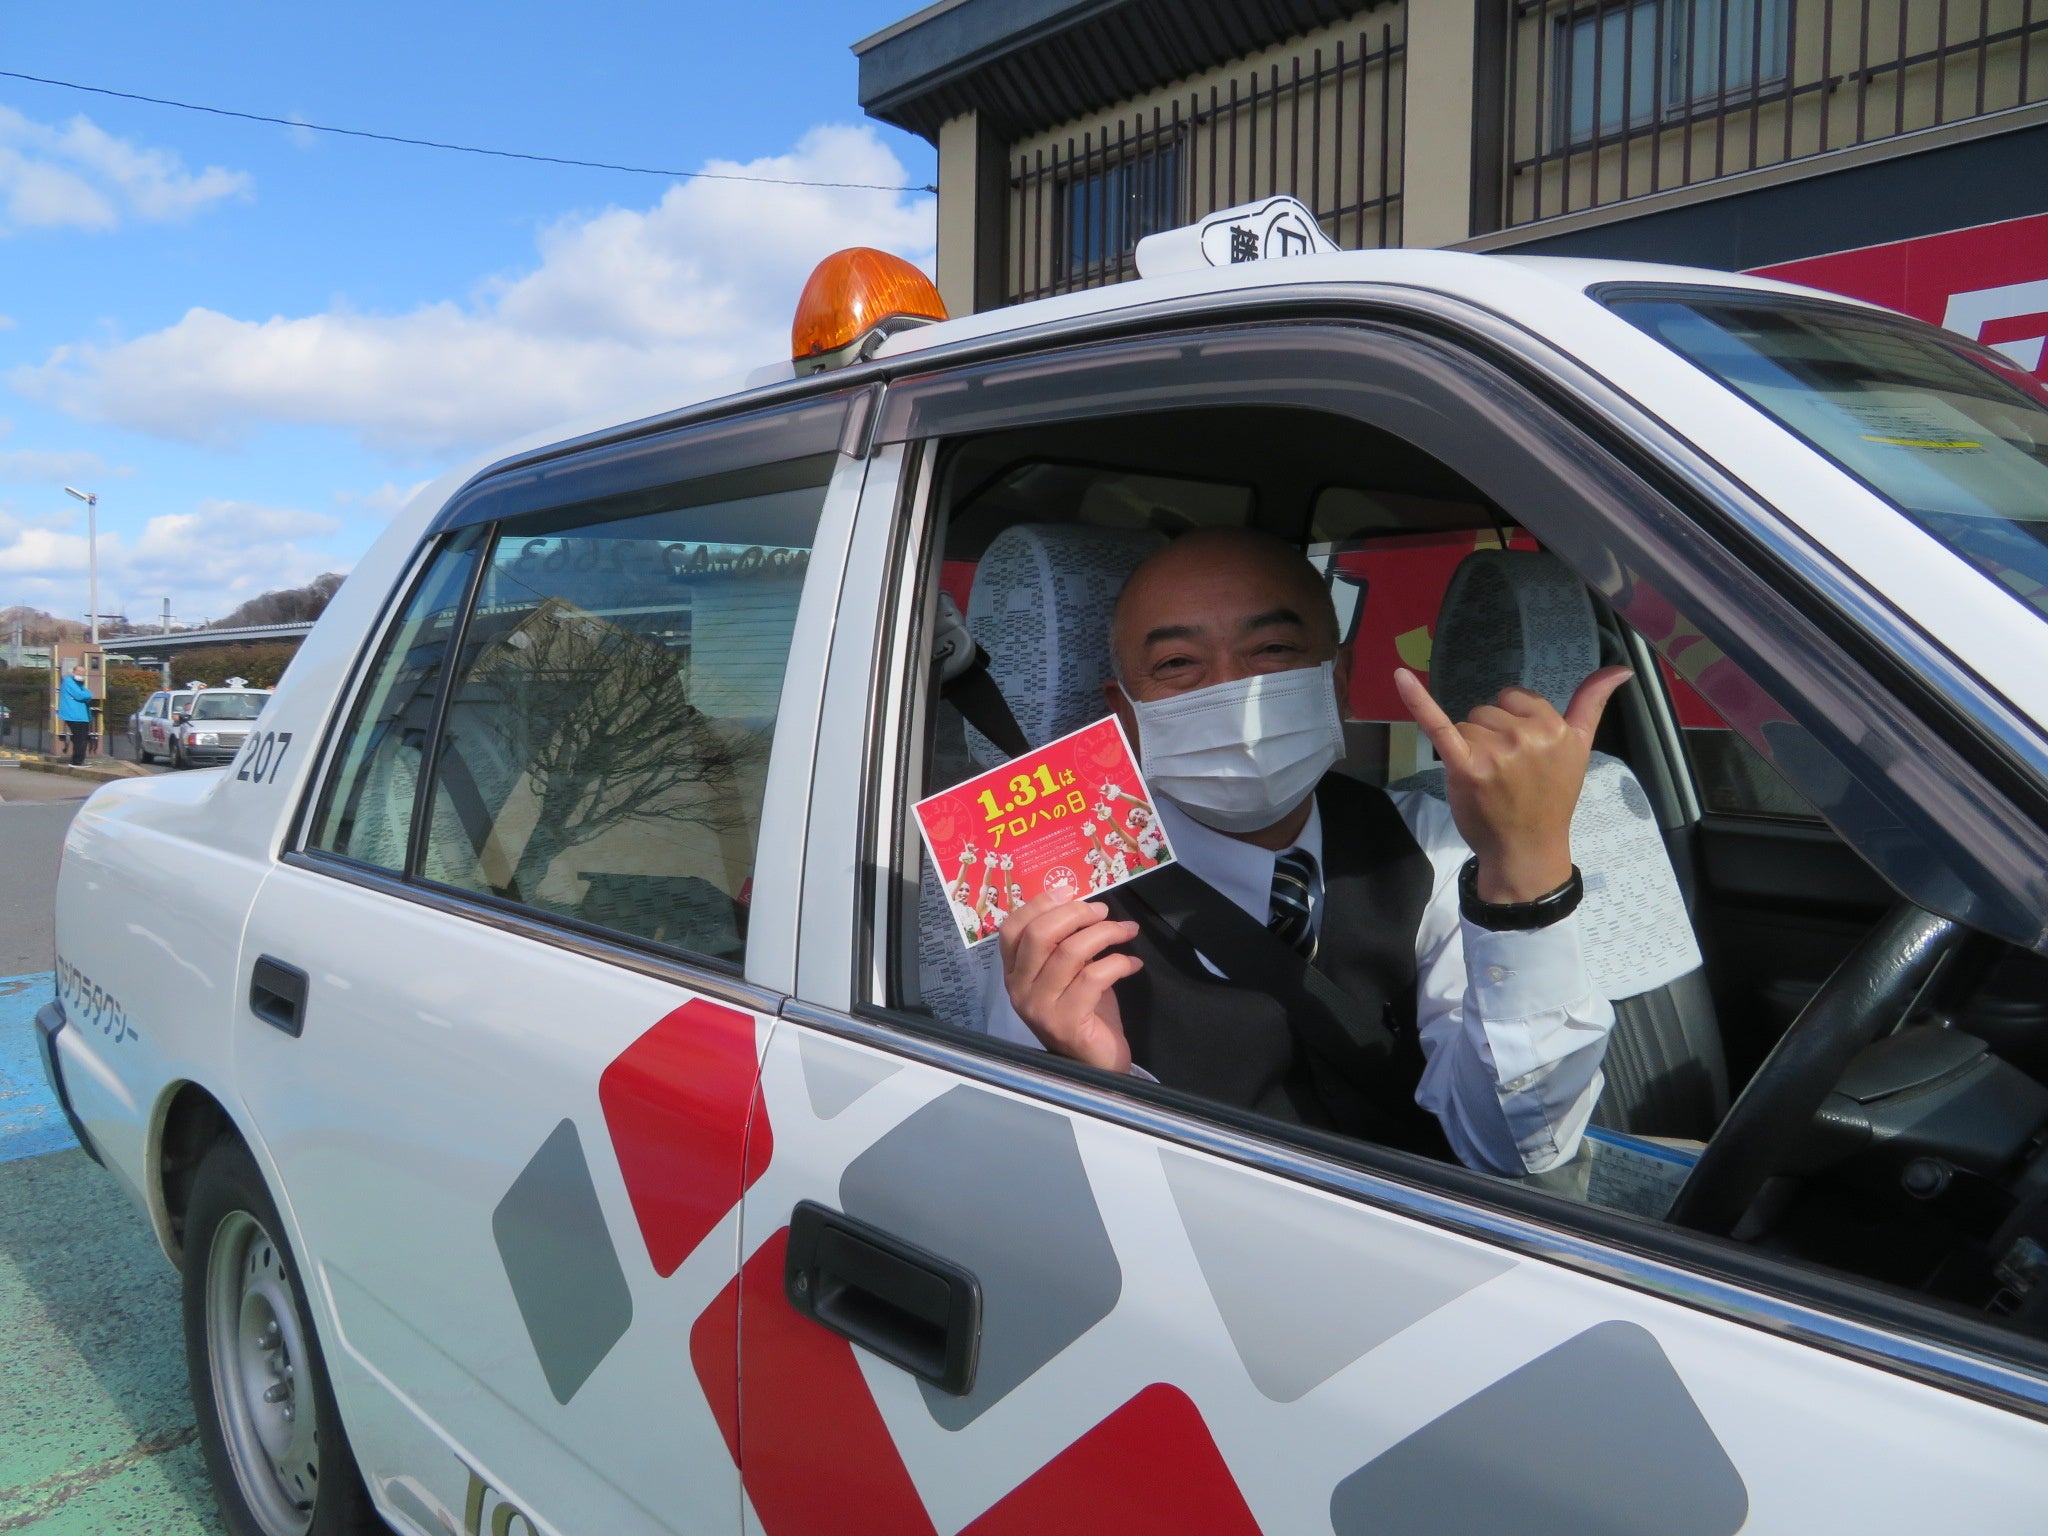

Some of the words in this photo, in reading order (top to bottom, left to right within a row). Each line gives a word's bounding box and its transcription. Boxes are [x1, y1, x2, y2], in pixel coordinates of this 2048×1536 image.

[238, 732, 292, 785] 207
[987, 790, 1086, 848] アロハの日
